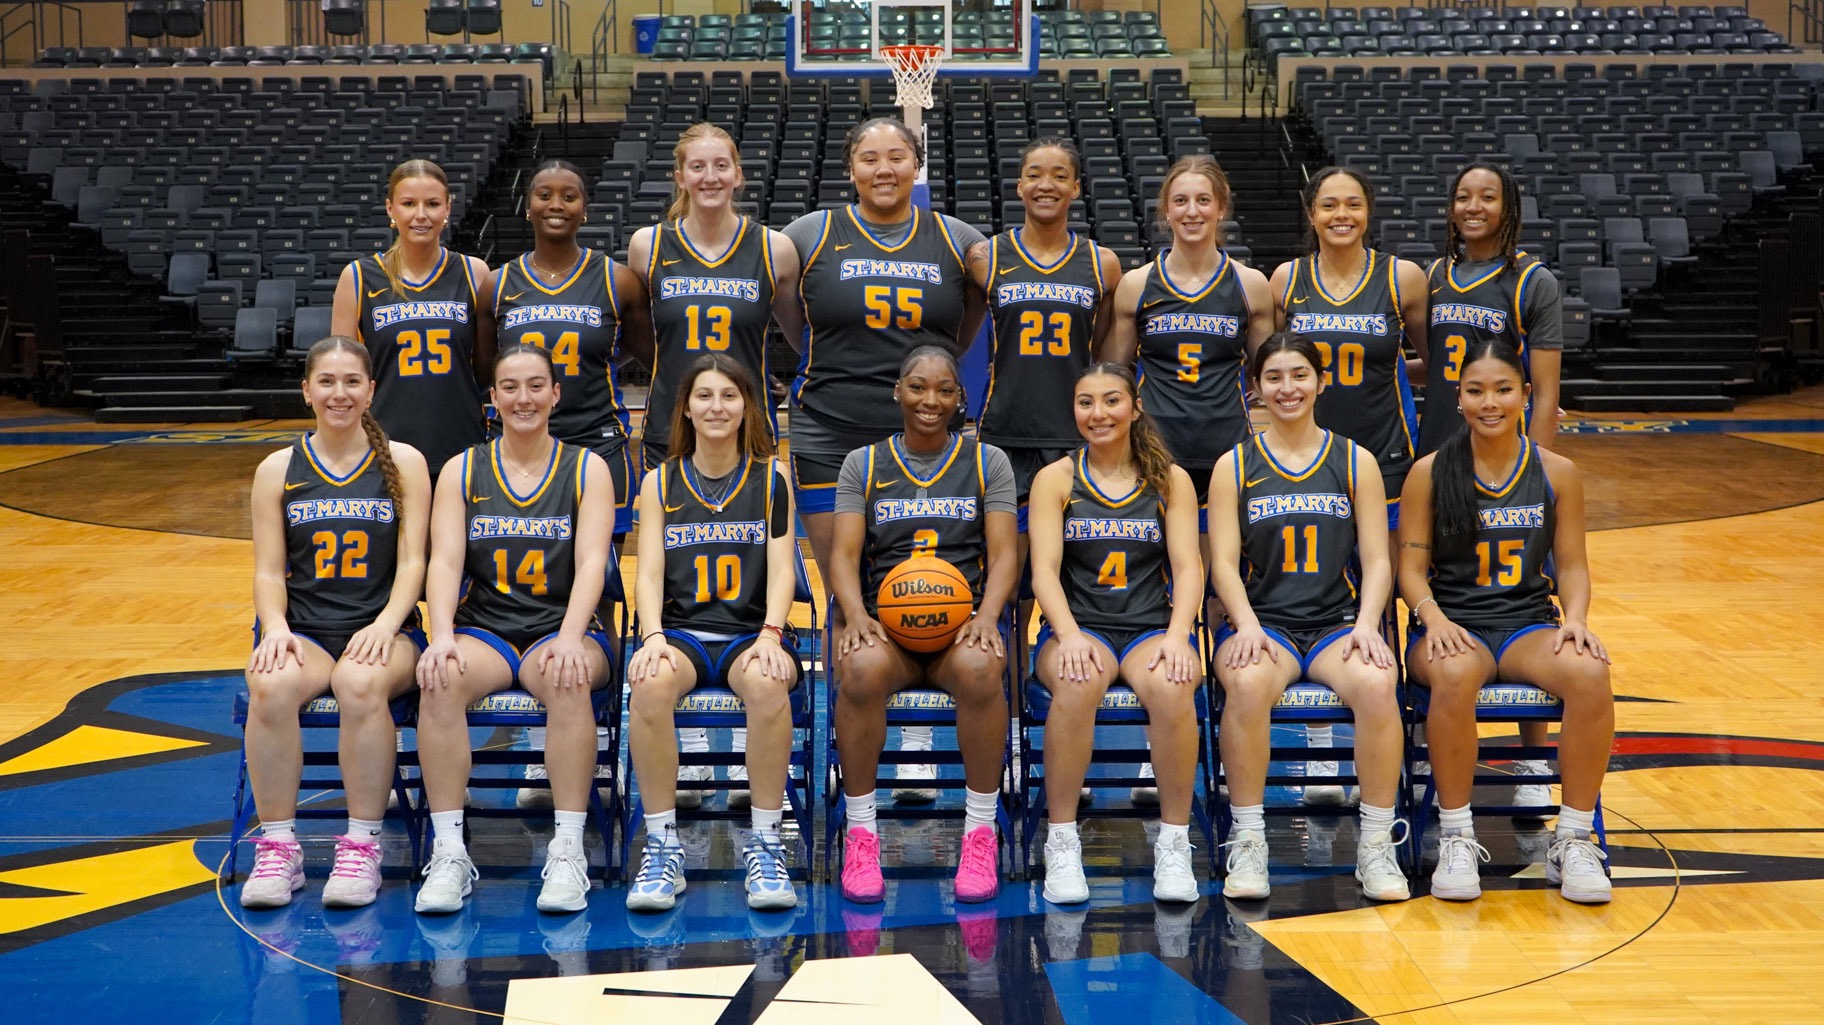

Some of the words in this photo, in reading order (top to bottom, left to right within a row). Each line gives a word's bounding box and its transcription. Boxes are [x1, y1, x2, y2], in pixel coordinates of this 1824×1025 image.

[684, 305, 732, 351] 13
[864, 285, 923, 329] 55
[396, 328, 452, 376] 25
[1019, 310, 1072, 356] 23
[1176, 342, 1203, 384] 5
[1443, 334, 1467, 382] 3
[312, 530, 369, 579] 22
[492, 548, 549, 595] 14
[1097, 551, 1129, 590] 4
[1281, 524, 1320, 574] 11
[1475, 540, 1525, 587] 15
[693, 554, 742, 603] 10
[891, 578, 954, 598] Wilson
[900, 611, 949, 628] NCAA
